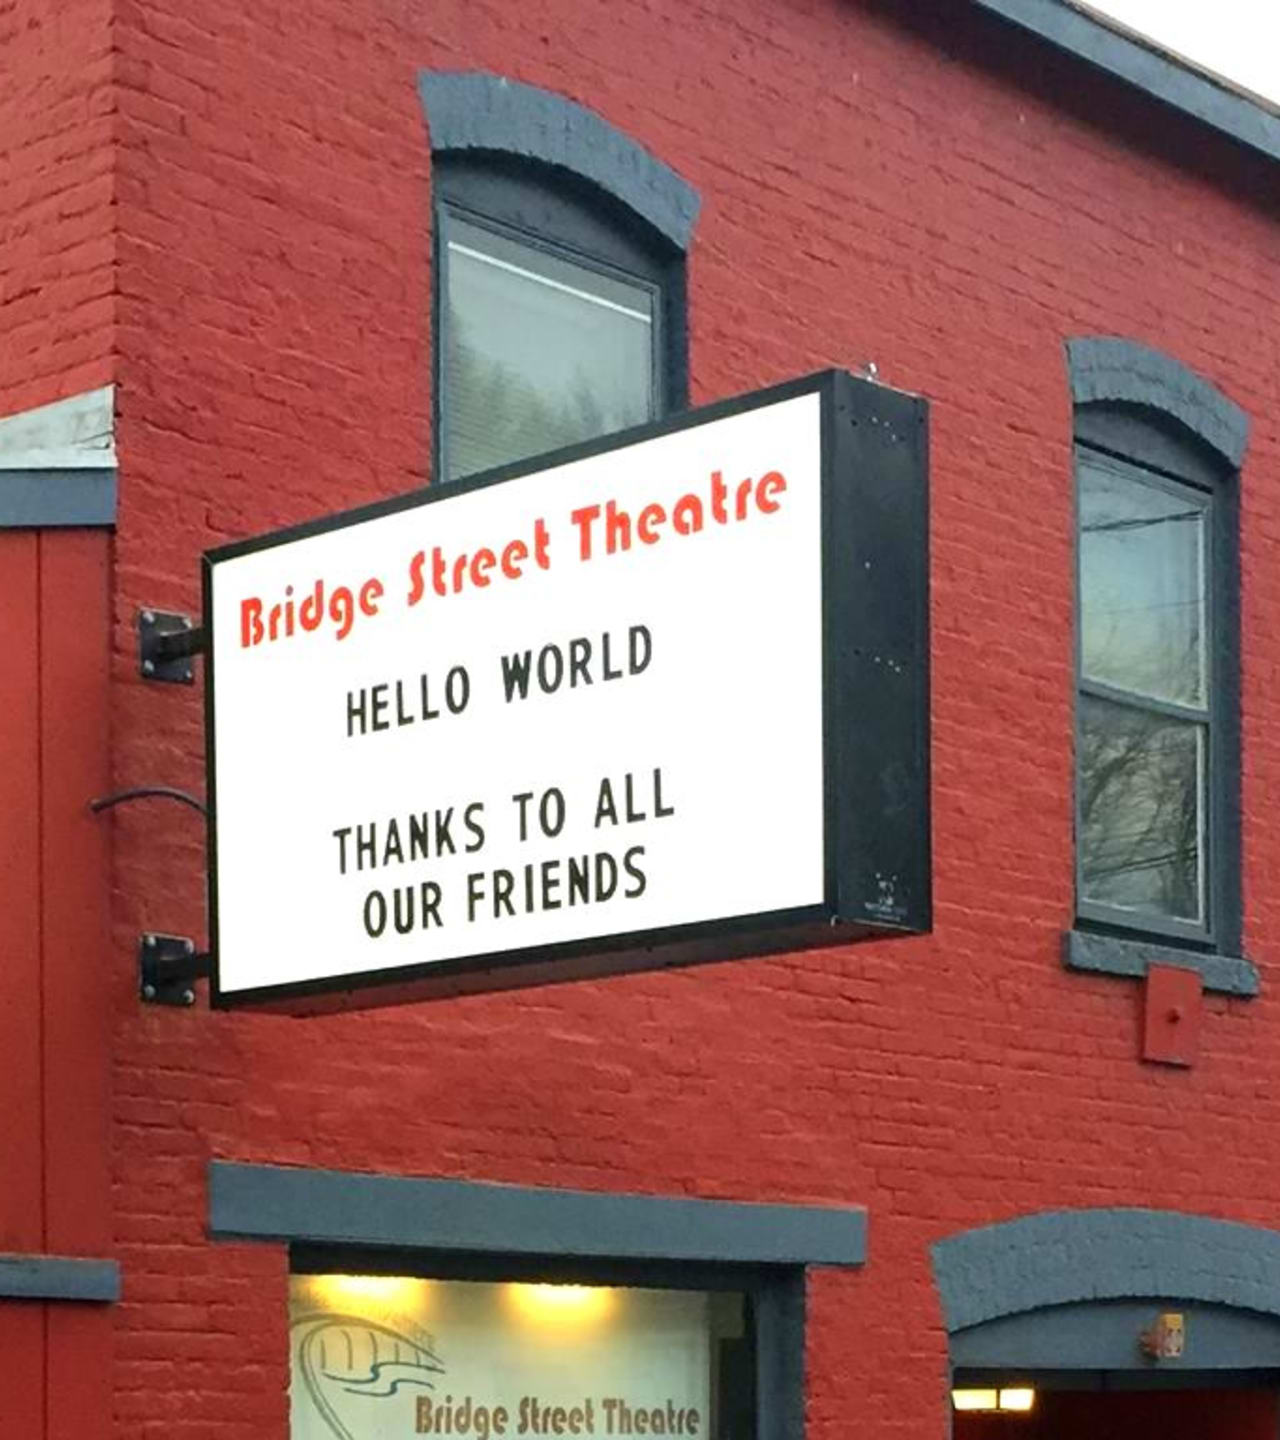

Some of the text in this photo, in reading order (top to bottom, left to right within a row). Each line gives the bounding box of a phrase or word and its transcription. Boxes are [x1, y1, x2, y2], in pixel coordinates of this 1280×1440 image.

[239, 470, 787, 650] Bridge Street Theatre
[347, 625, 652, 737] HELLO WORLD
[333, 768, 674, 874] THANKS TO ALL
[363, 846, 647, 938] OUR FRIENDS
[517, 1396, 595, 1435] Street
[602, 1398, 700, 1436] Theatre
